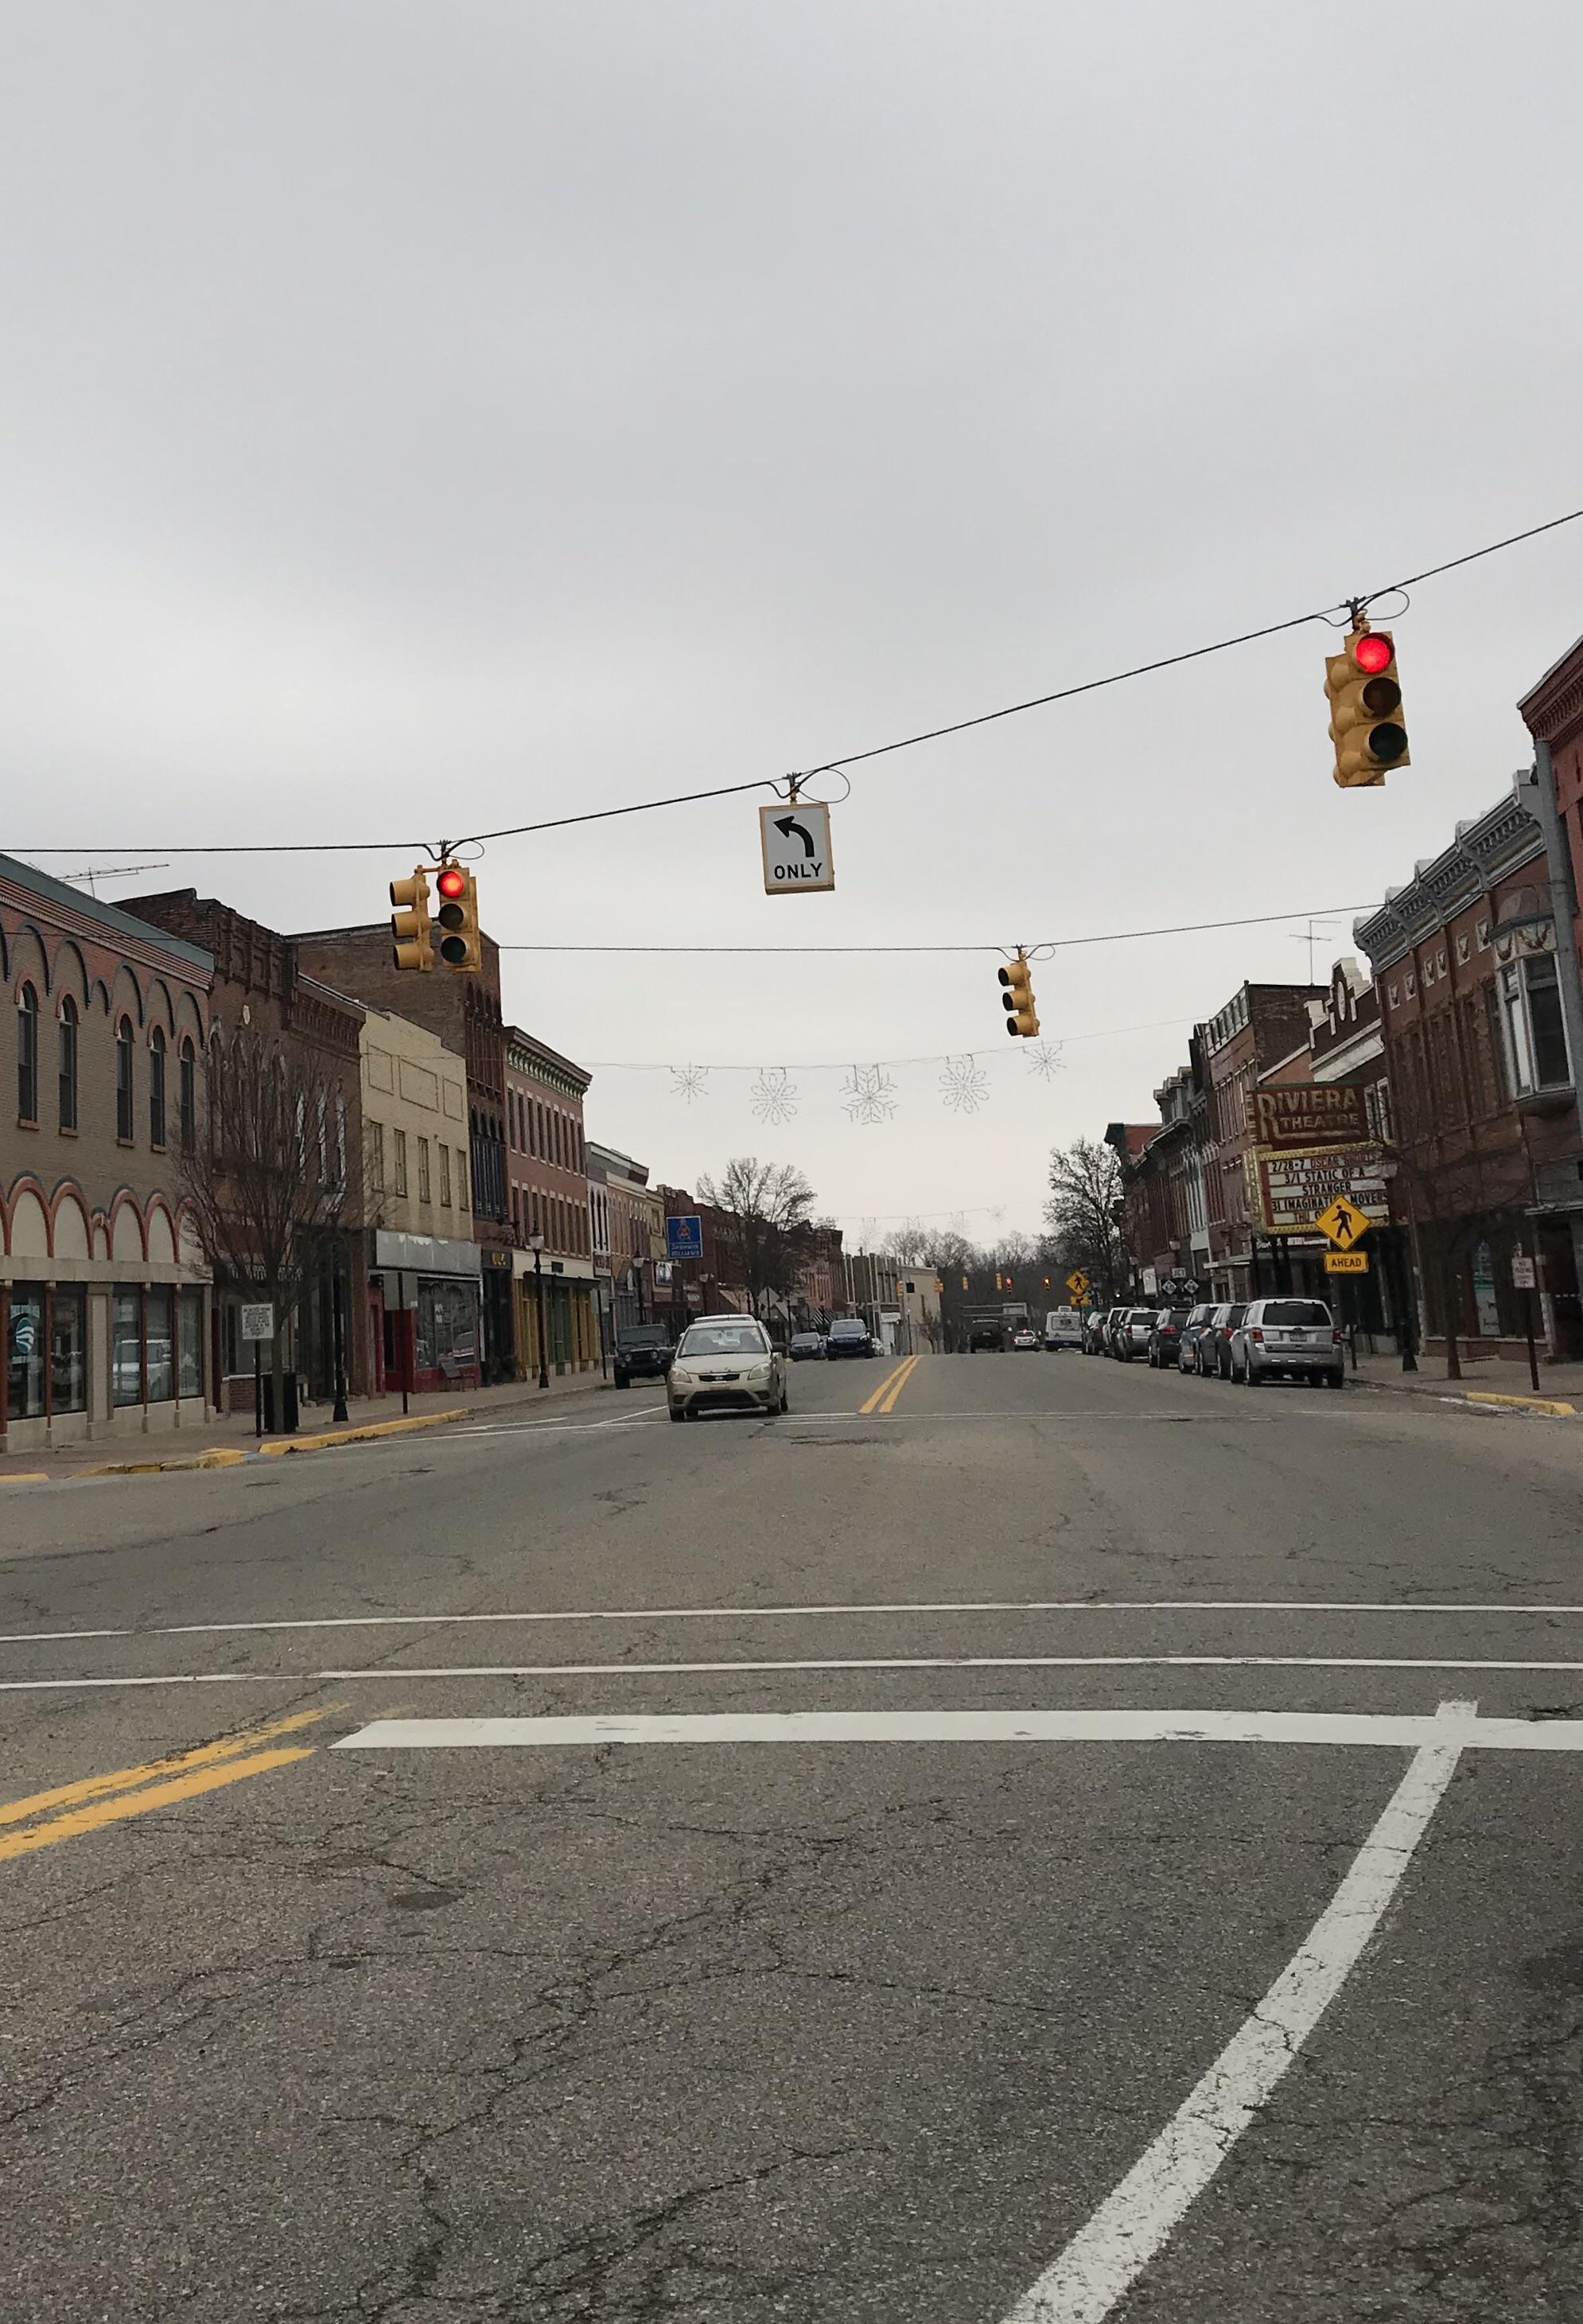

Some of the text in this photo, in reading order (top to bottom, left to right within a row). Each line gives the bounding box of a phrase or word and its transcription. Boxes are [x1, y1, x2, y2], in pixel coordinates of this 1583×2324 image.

[774, 862, 823, 879] ONLY
[1257, 1088, 1358, 1141] RIVIERA
[1280, 1114, 1360, 1129] THEATRE
[1311, 1155, 1339, 1168] OSCAR
[1285, 1167, 1365, 1184] 3/1 STATIC OF A
[1302, 1181, 1352, 1195] STRANGER
[1285, 1196, 1333, 1210] IMAGINATI
[1294, 1210, 1310, 1222] THU
[1332, 1258, 1362, 1267] AHEAD
